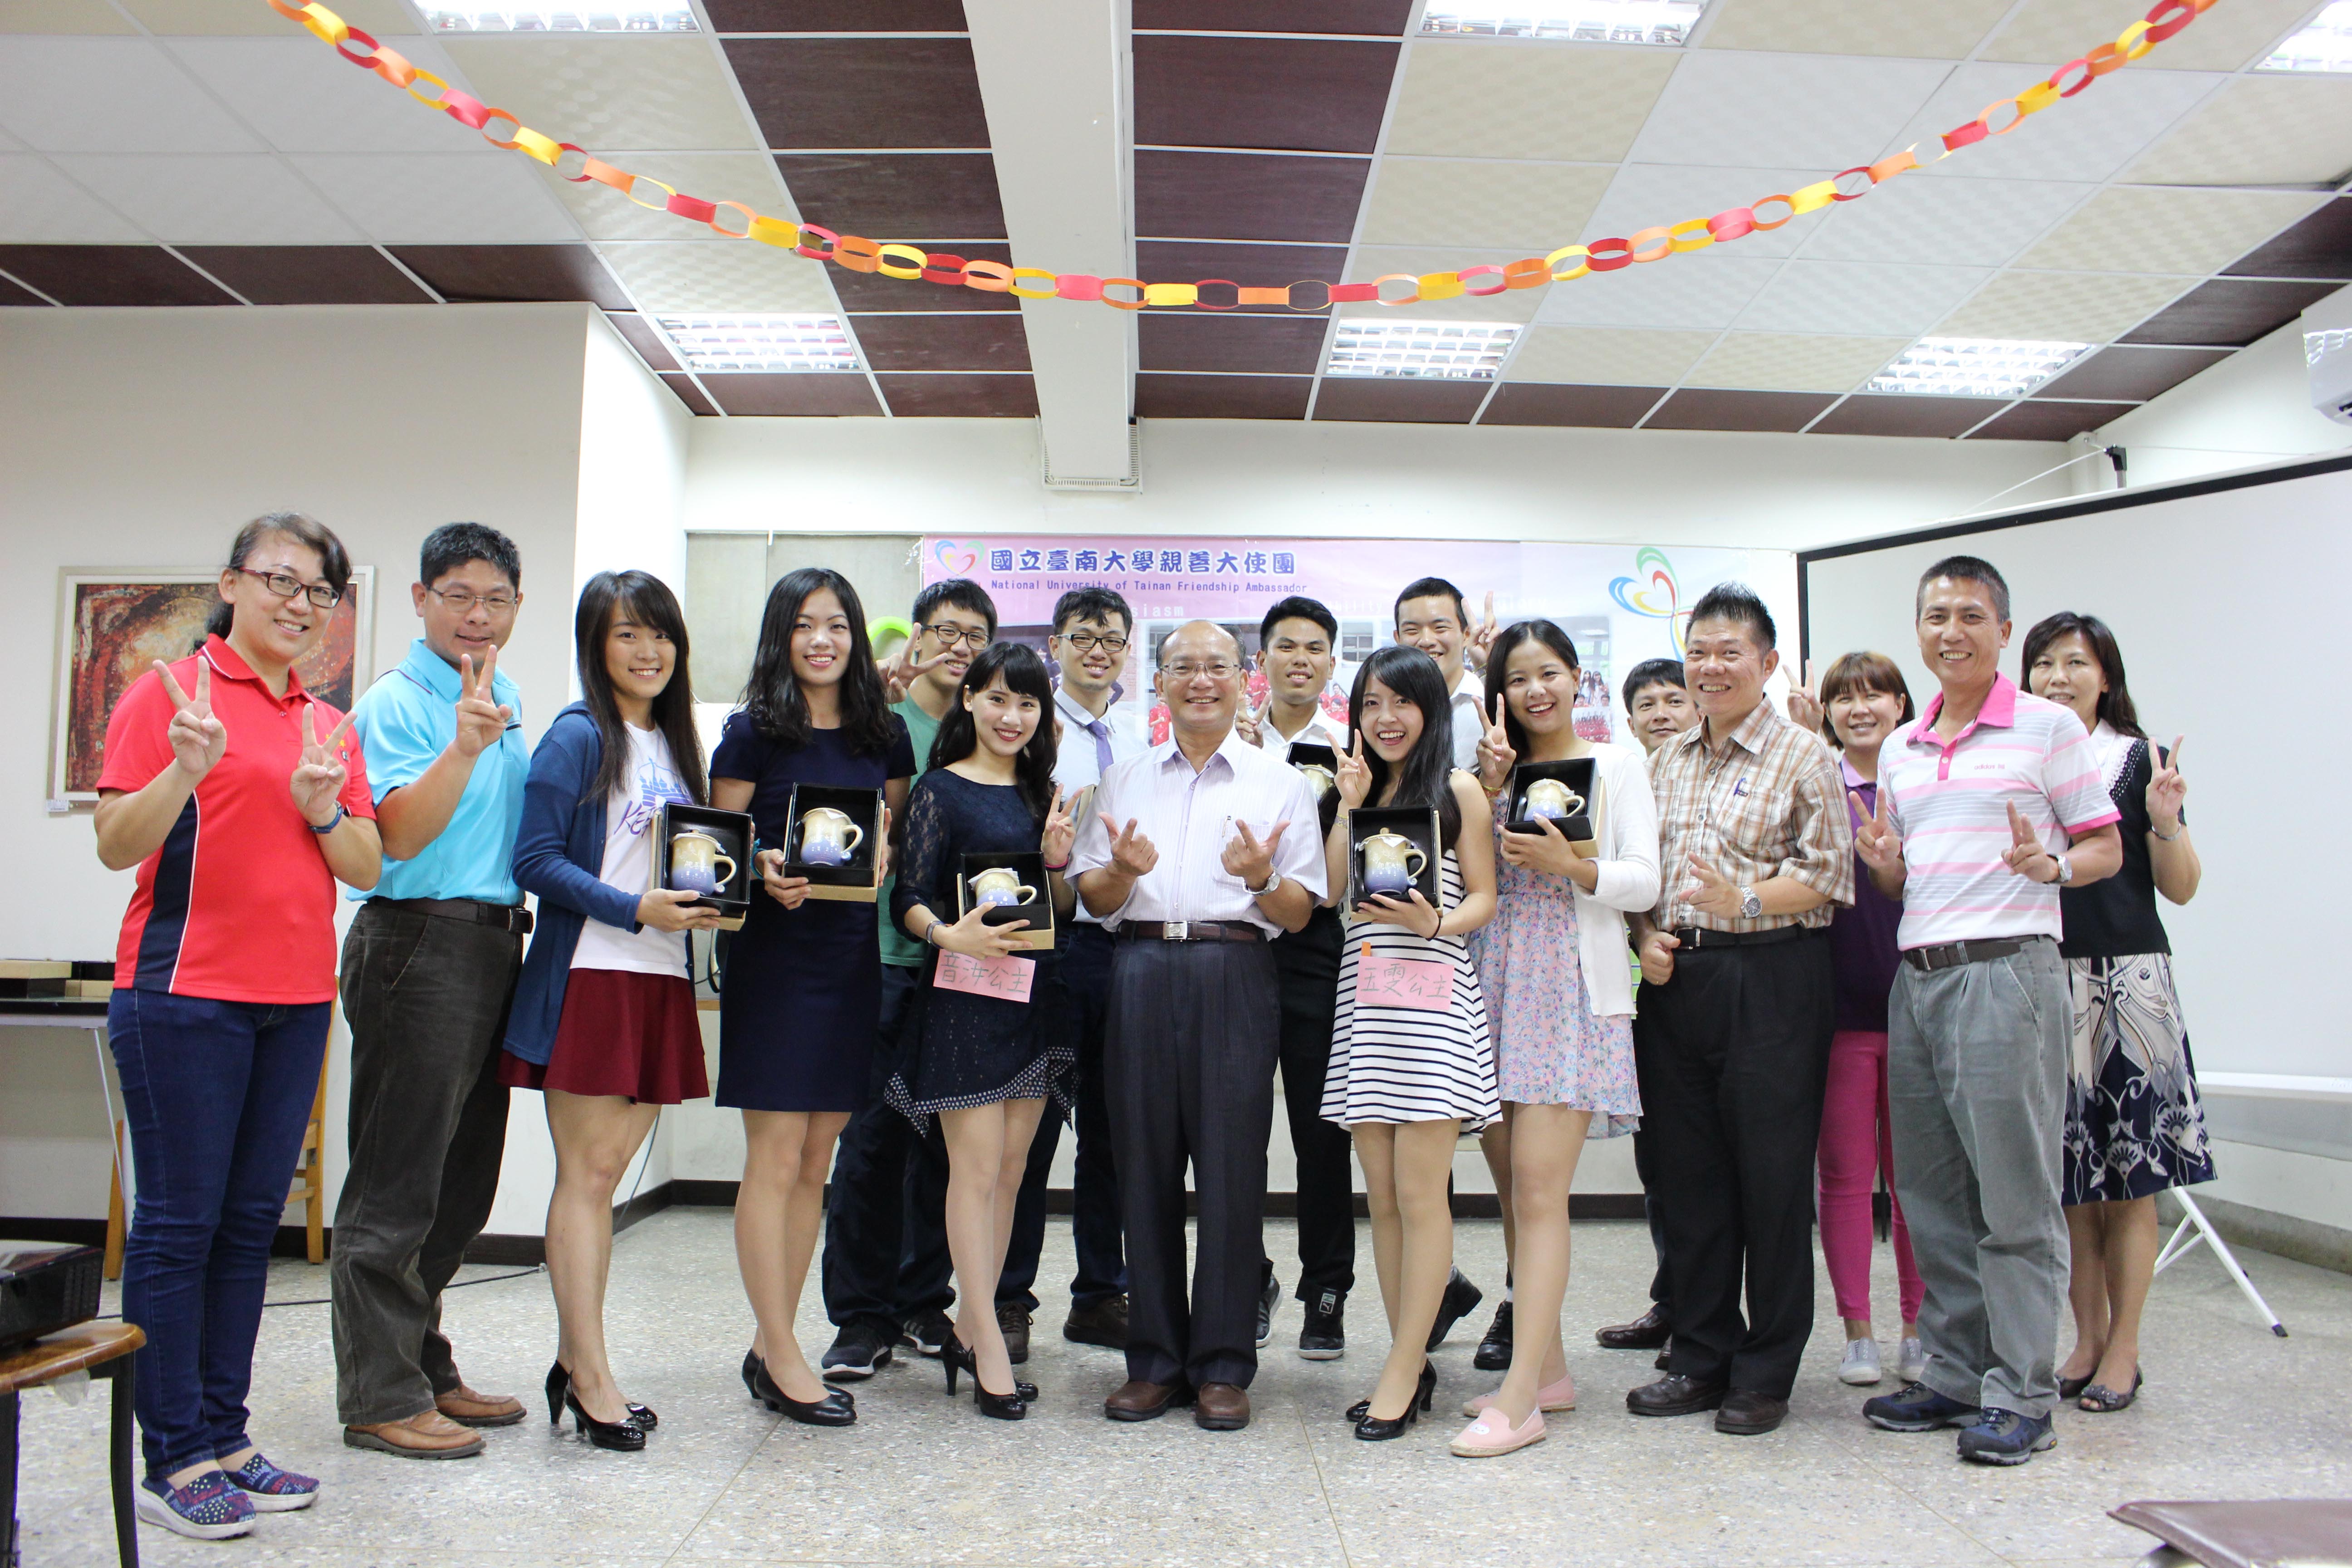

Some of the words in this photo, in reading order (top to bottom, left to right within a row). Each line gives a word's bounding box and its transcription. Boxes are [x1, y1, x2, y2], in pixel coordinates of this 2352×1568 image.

[991, 549, 1294, 574] 國立臺南大學親善大使團
[991, 580, 1039, 589] National
[1048, 580, 1108, 590] University
[1116, 581, 1127, 590] of
[1135, 581, 1171, 590] Tainan
[1178, 582, 1239, 593] Friendship
[1246, 583, 1307, 593] Ambassador
[1130, 603, 1184, 617] siasm
